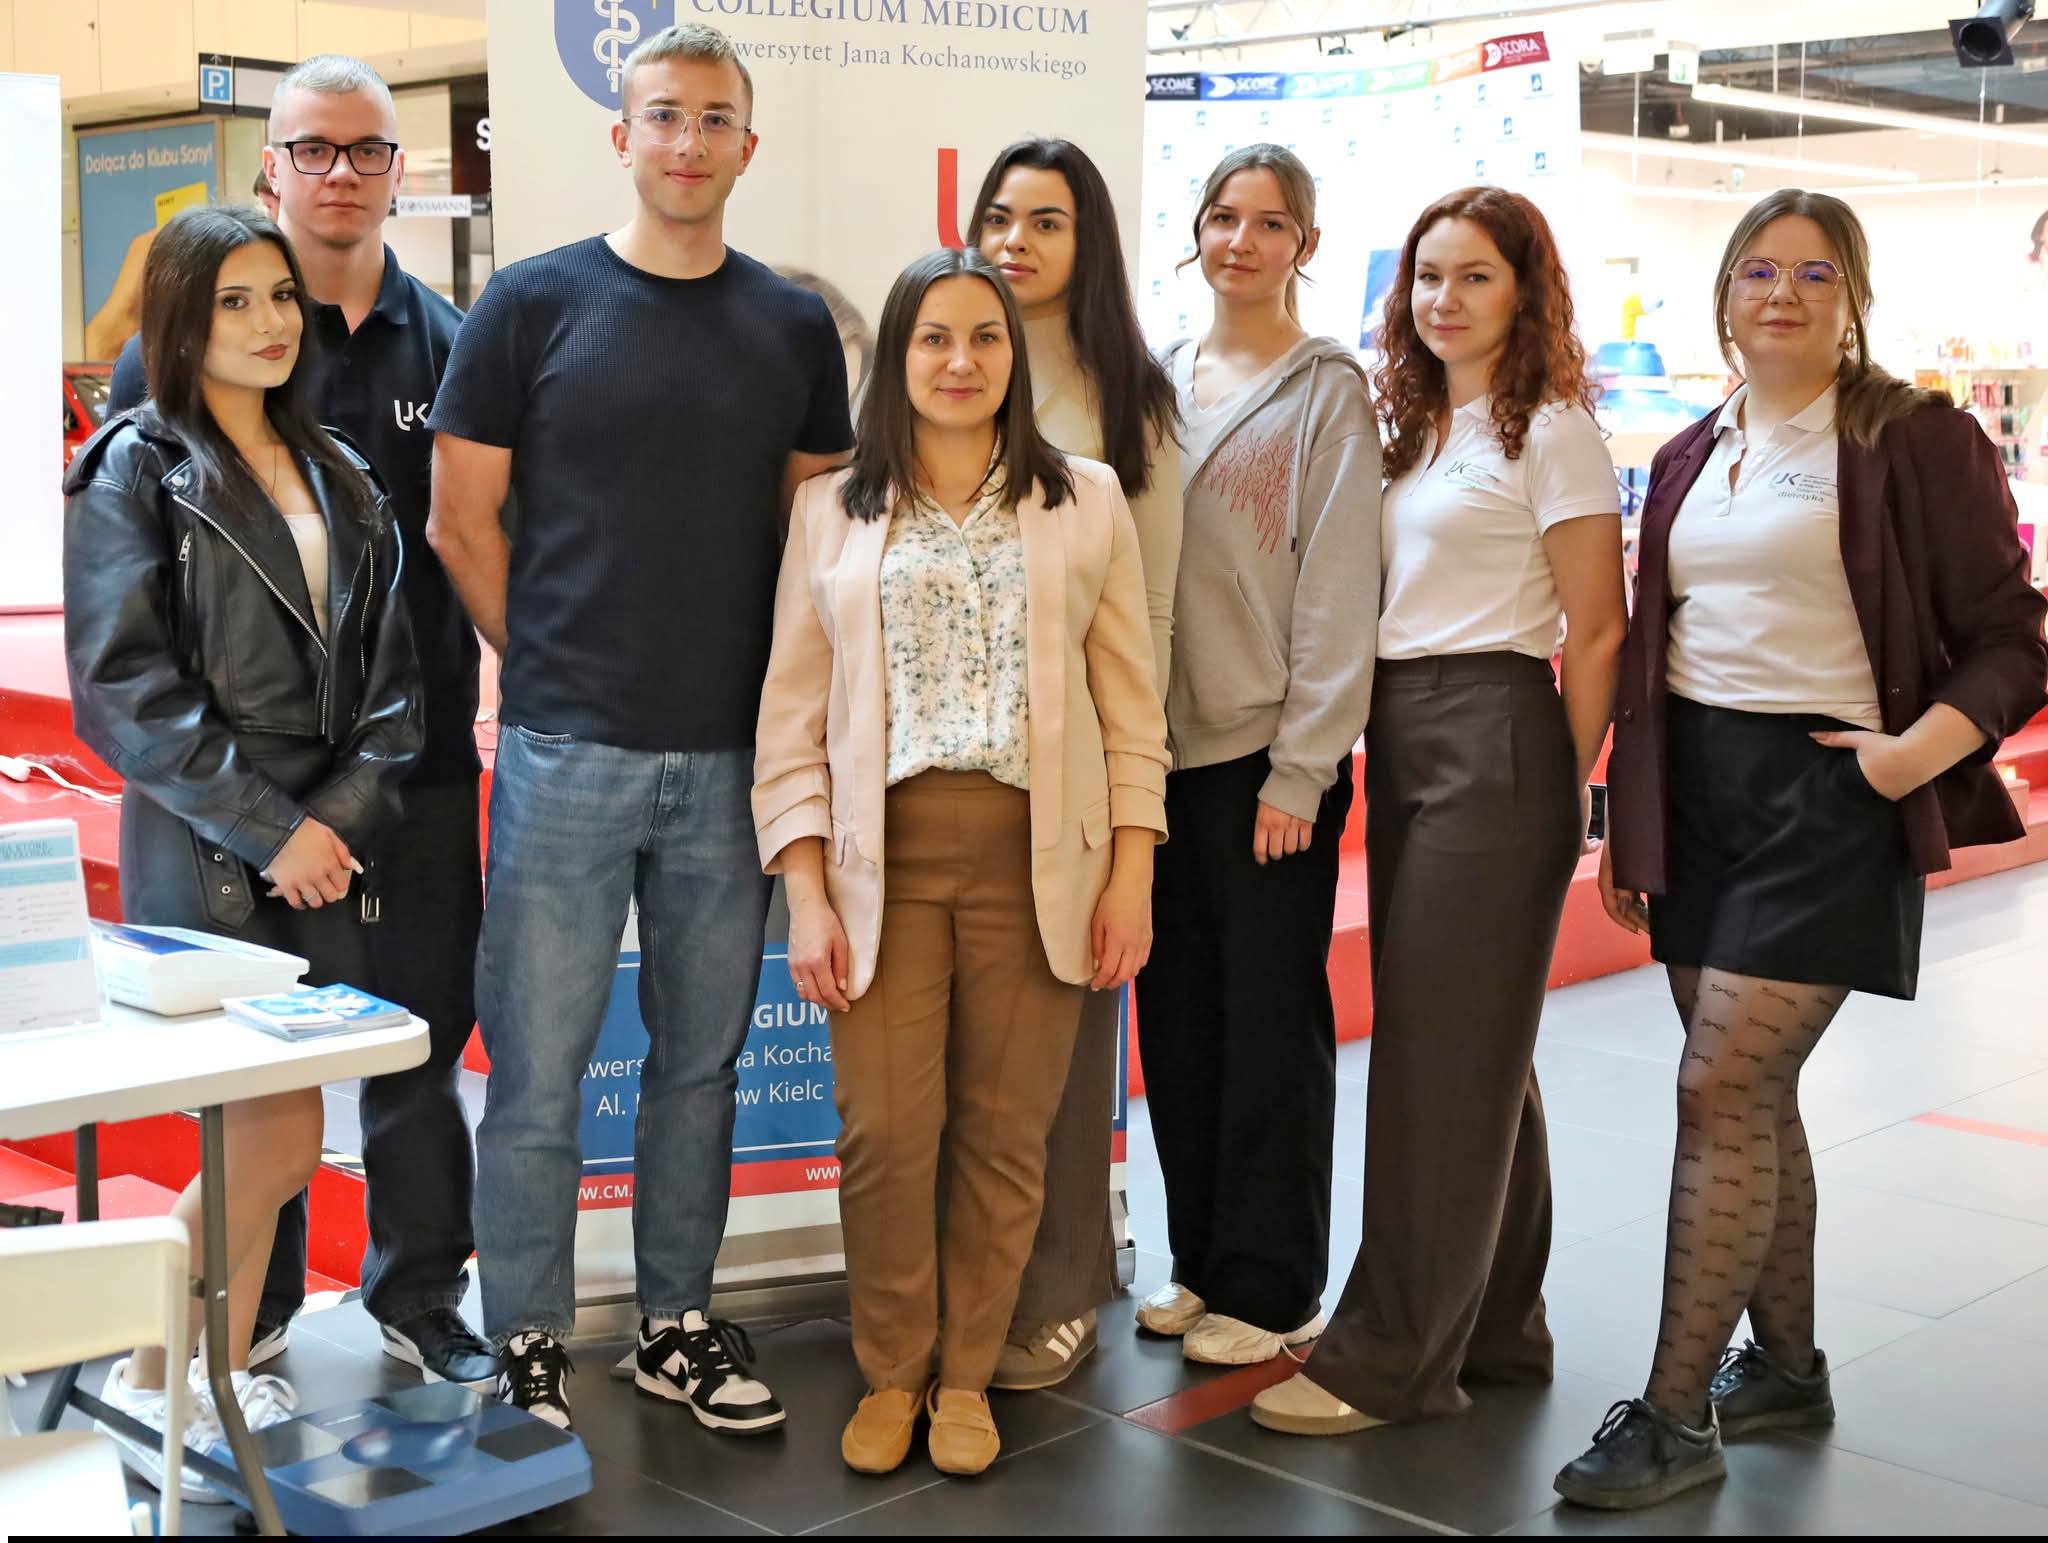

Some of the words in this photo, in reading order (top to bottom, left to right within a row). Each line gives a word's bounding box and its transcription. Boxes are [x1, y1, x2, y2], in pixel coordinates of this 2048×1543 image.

[921, 0, 1089, 34] MEDICUM
[839, 41, 891, 68] Jana
[902, 44, 1087, 80] Kochanowskiego
[128, 149, 145, 169] do
[596, 1092, 627, 1117] Al.
[769, 1080, 824, 1104] Kielc
